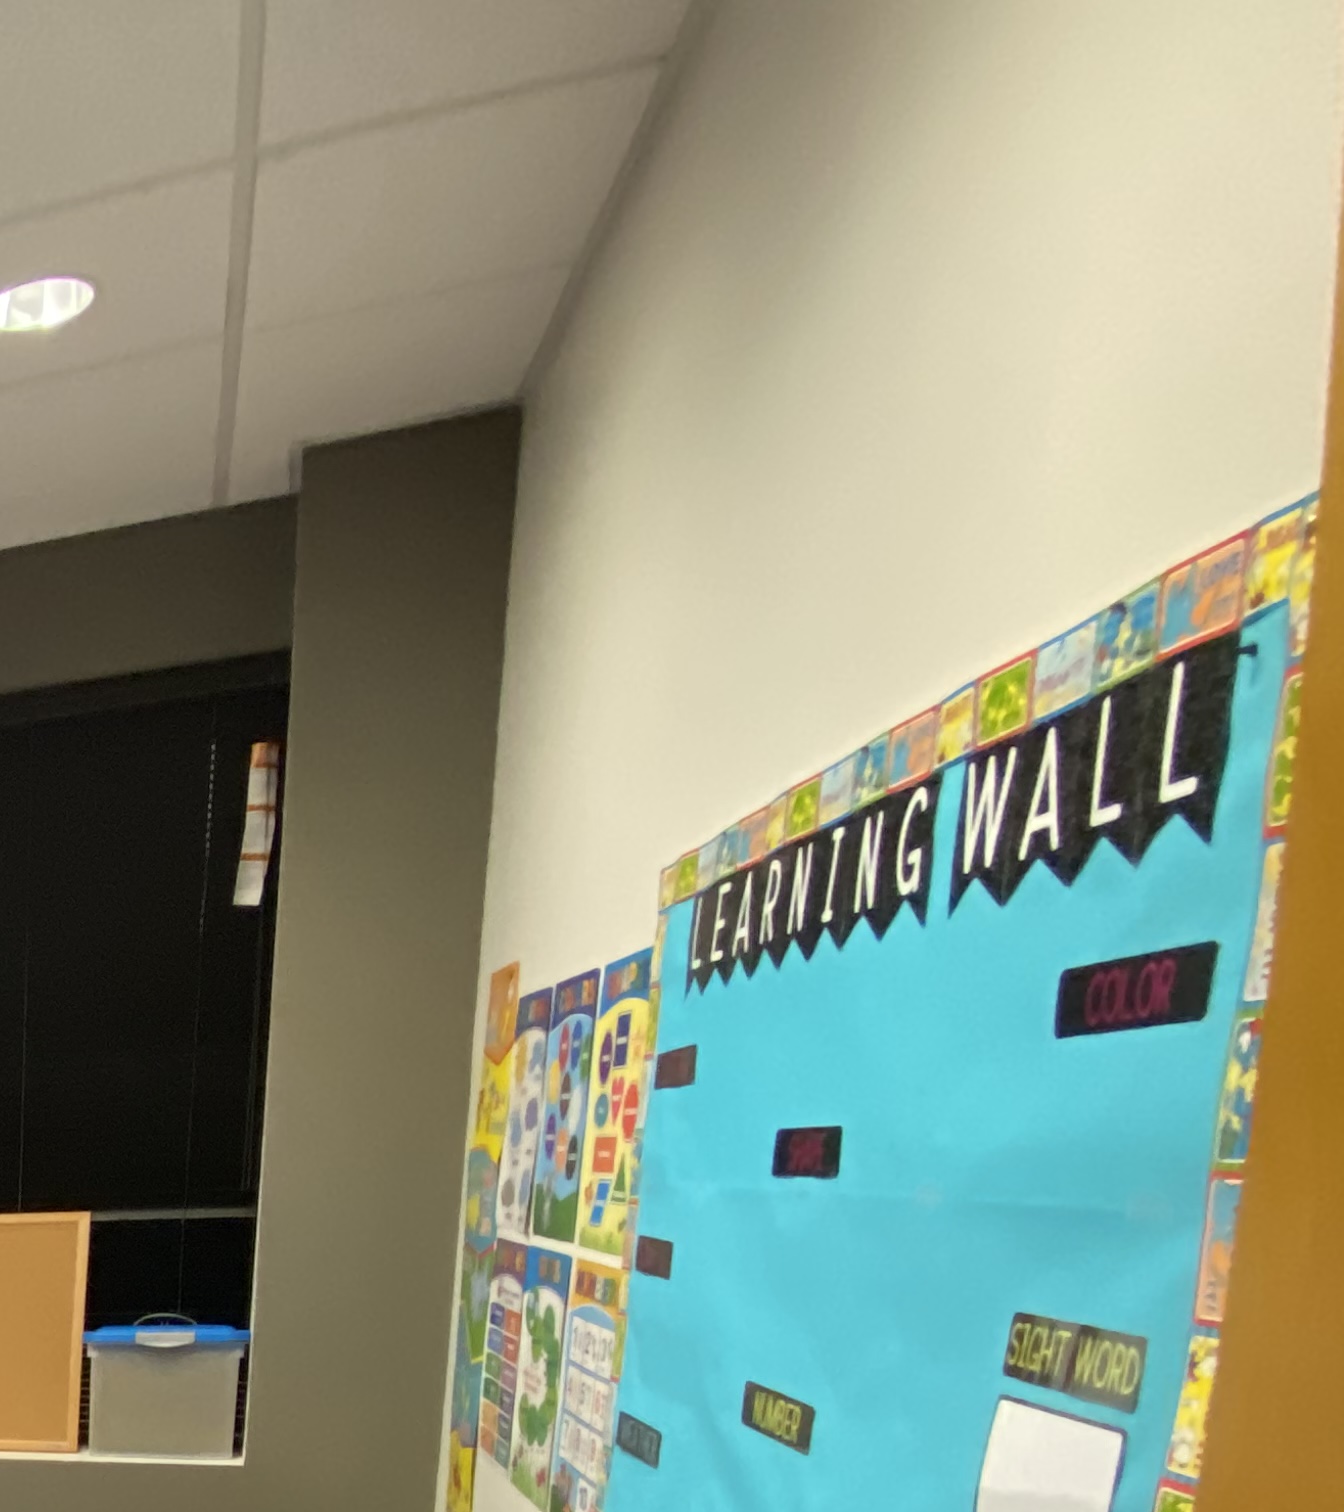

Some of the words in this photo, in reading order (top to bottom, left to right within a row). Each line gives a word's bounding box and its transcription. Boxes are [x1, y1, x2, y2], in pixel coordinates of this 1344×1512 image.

[690, 786, 929, 971] LEARNING
[962, 660, 1200, 875] WALL
[1083, 958, 1178, 1026] COLOR
[1007, 1322, 1072, 1377] SIGHT
[1073, 1333, 1141, 1395] WORD
[752, 1390, 802, 1444] NUMBER
